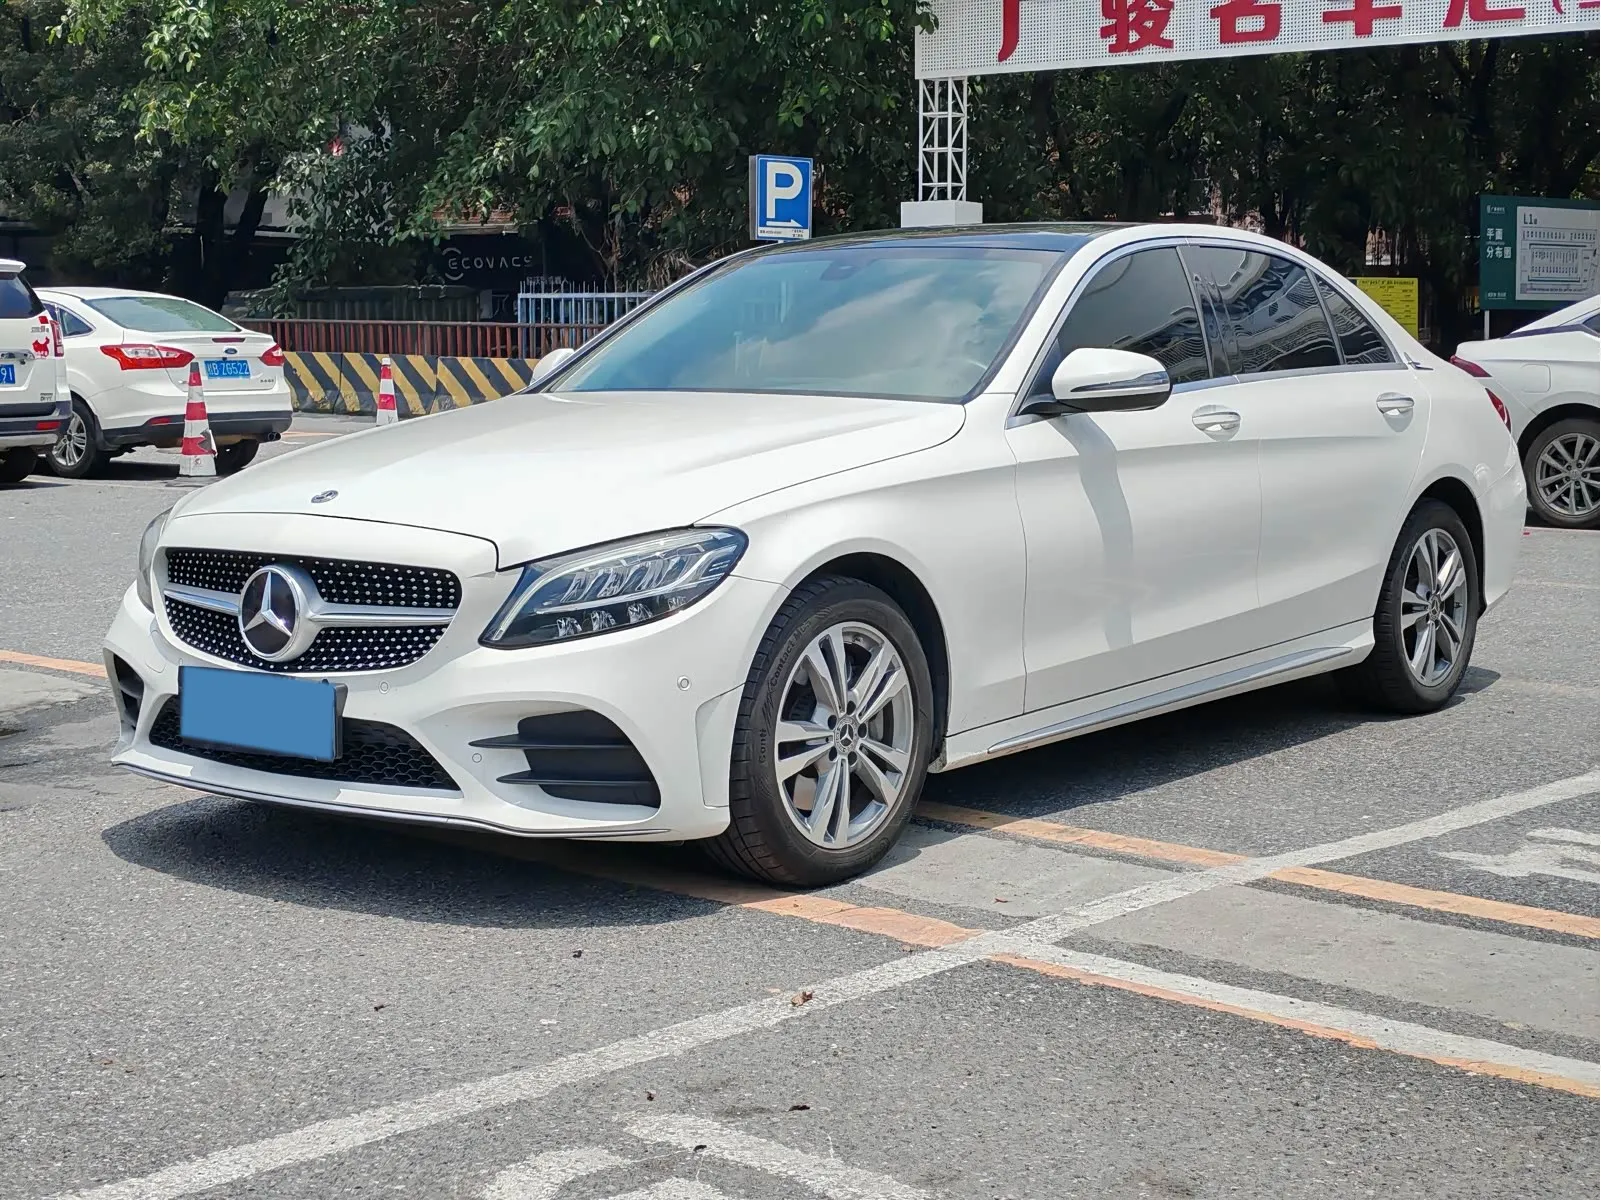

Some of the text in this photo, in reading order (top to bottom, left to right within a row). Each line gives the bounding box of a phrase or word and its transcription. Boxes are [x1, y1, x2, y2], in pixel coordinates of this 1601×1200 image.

[766, 161, 804, 219] P
[1486, 227, 1503, 240] 平面
[1486, 246, 1512, 259] 分布图
[447, 255, 533, 270] ECOVACS
